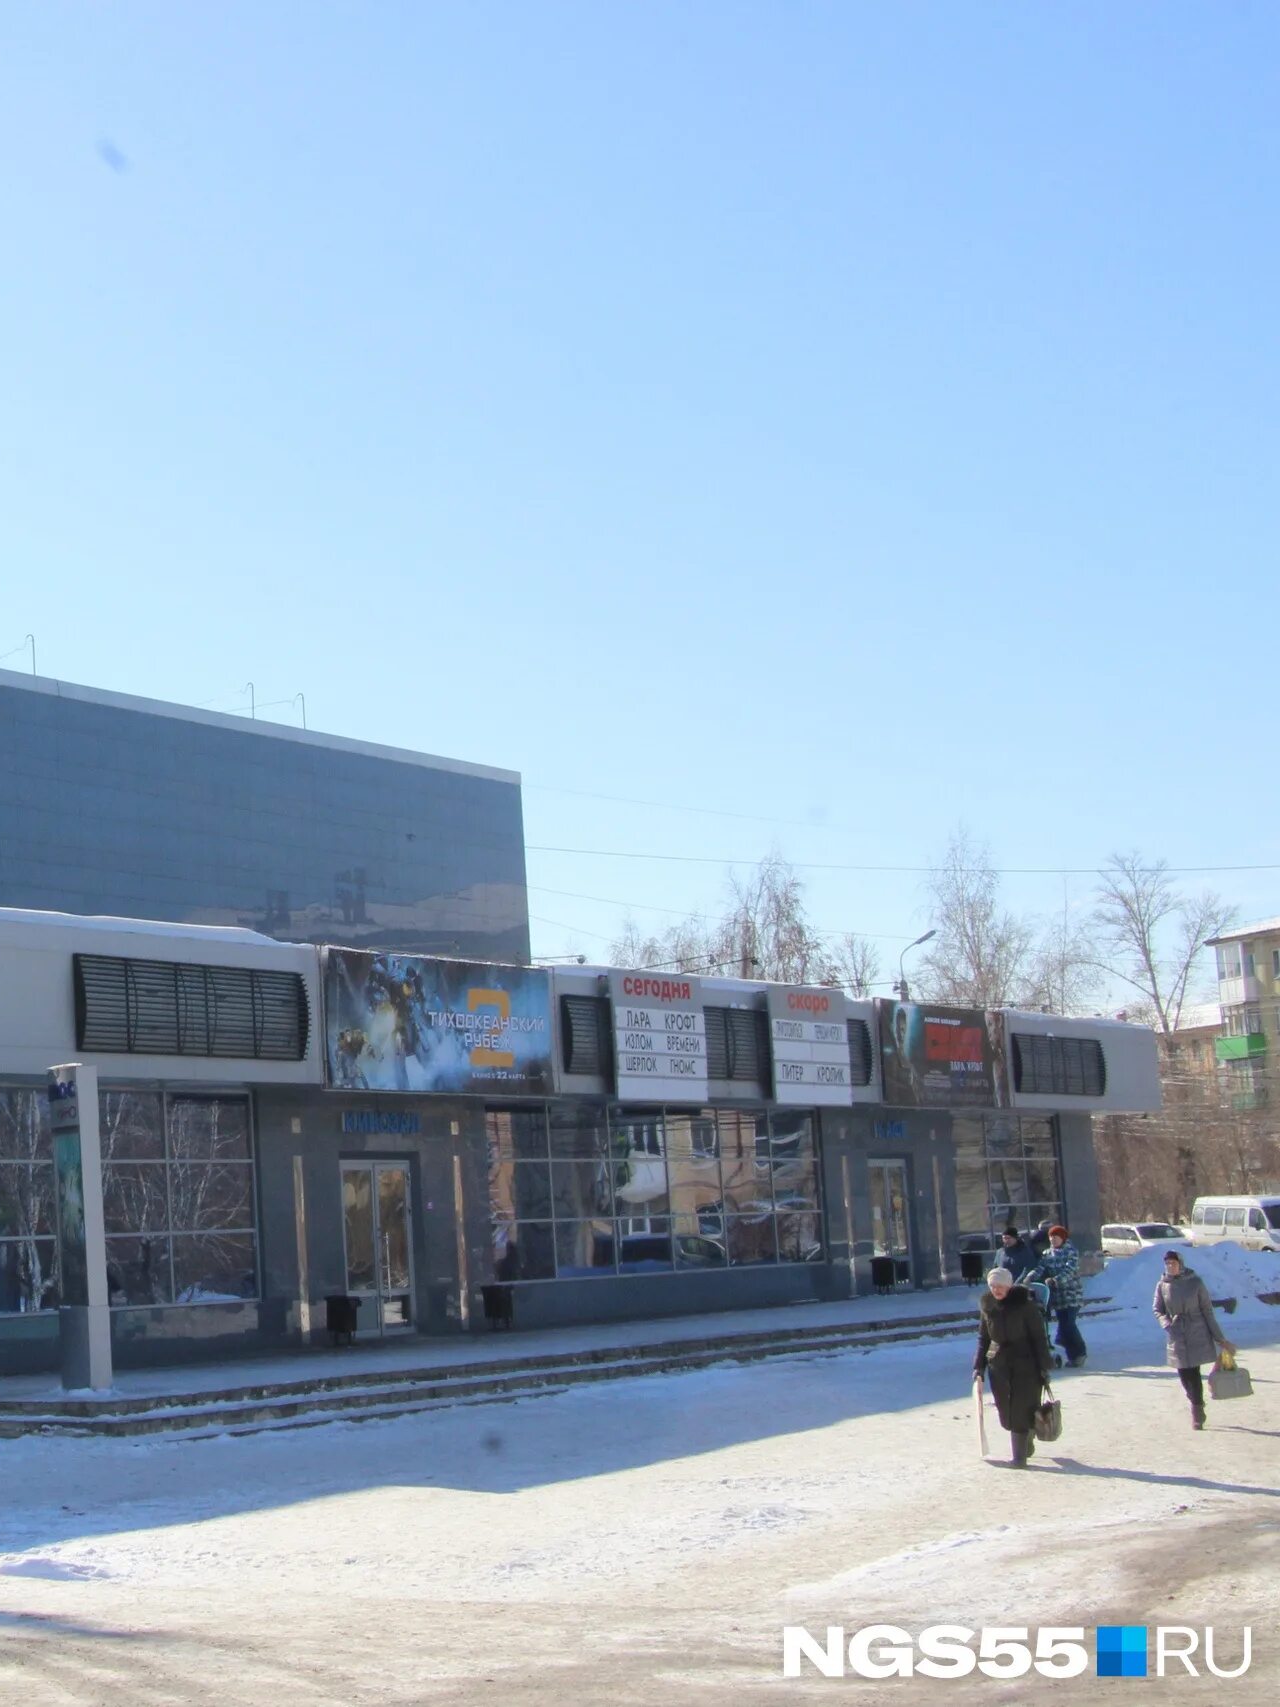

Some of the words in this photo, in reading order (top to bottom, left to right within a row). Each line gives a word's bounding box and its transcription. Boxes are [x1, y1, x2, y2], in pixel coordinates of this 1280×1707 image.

[623, 977, 691, 1002] сегодня
[787, 992, 829, 1015] скоро
[428, 1011, 545, 1033] ТИХООКЕАНСКИЙ
[626, 1010, 652, 1028] ЛАРА
[664, 1012, 696, 1031] КРОФТ
[464, 1032, 513, 1050] РУБЕЖ
[624, 1033, 653, 1051] ИЗЛОМ
[666, 1035, 700, 1053] ВРЕМЕНИ
[625, 1056, 658, 1073] ШЕРЛОК
[781, 1063, 804, 1081] ПИТЕР
[816, 1065, 845, 1083] КРОЛИК
